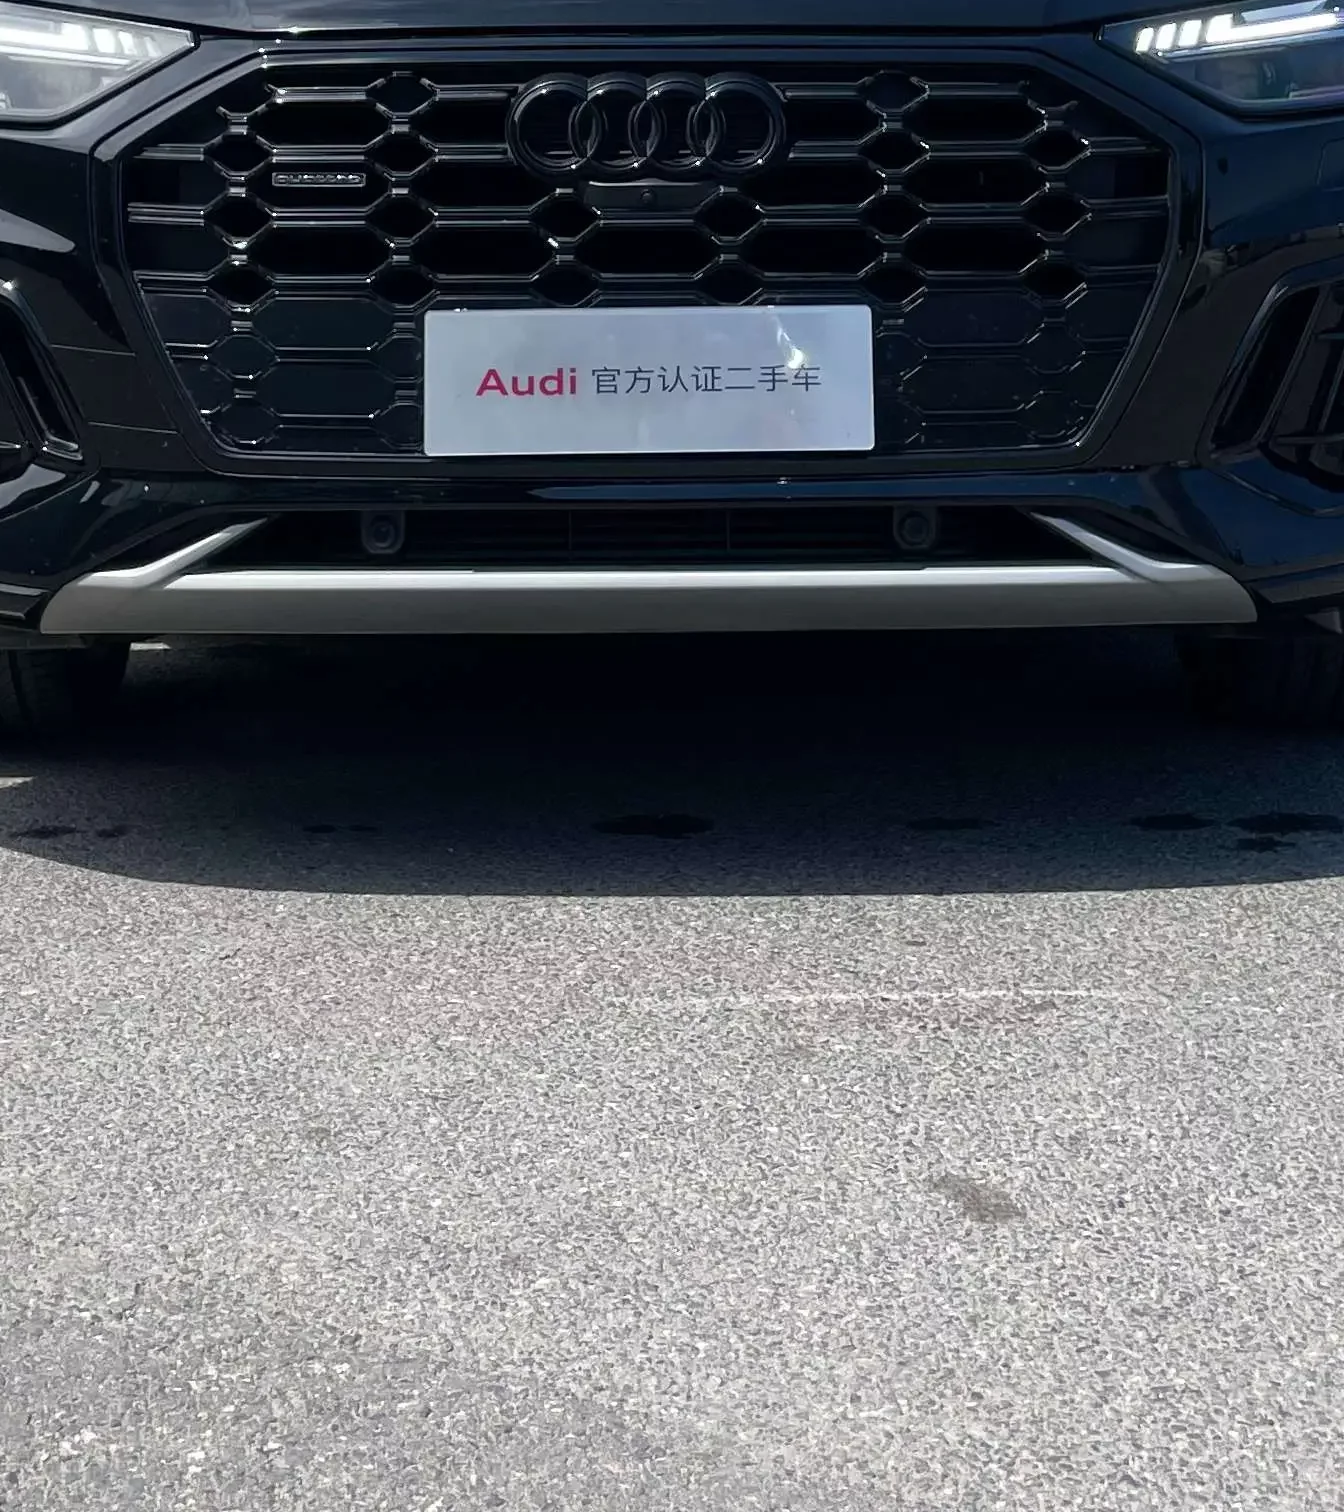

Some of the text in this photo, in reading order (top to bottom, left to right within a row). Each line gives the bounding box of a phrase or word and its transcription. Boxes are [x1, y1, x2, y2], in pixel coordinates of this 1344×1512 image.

[476, 365, 822, 397] Audi 官方认证二手车
